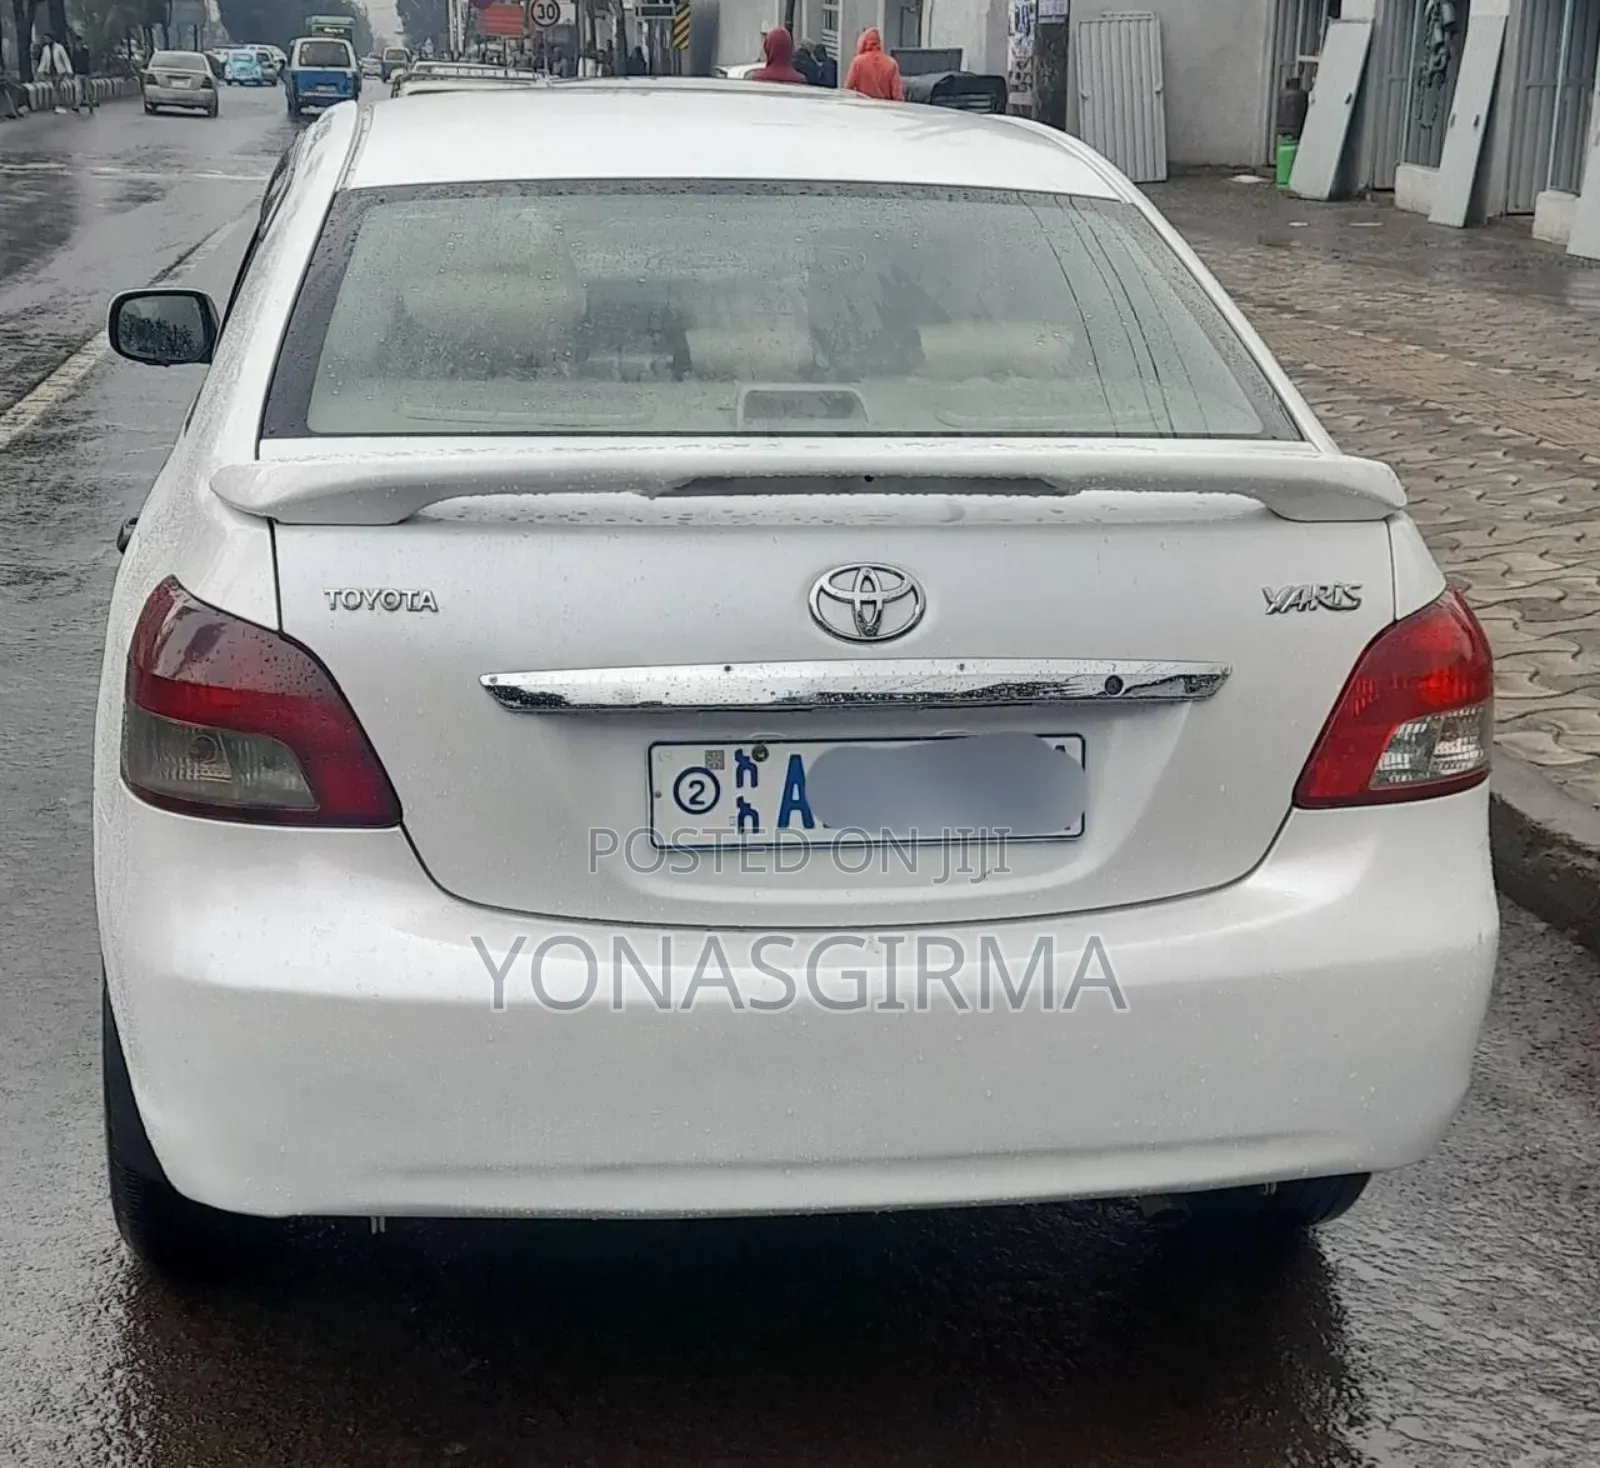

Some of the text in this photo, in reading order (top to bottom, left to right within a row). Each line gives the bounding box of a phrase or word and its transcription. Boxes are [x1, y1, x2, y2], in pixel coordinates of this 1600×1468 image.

[537, 3, 556, 20] 30
[324, 588, 438, 612] TOYOTA
[1262, 583, 1362, 614] YARIS
[688, 780, 705, 805] 2
